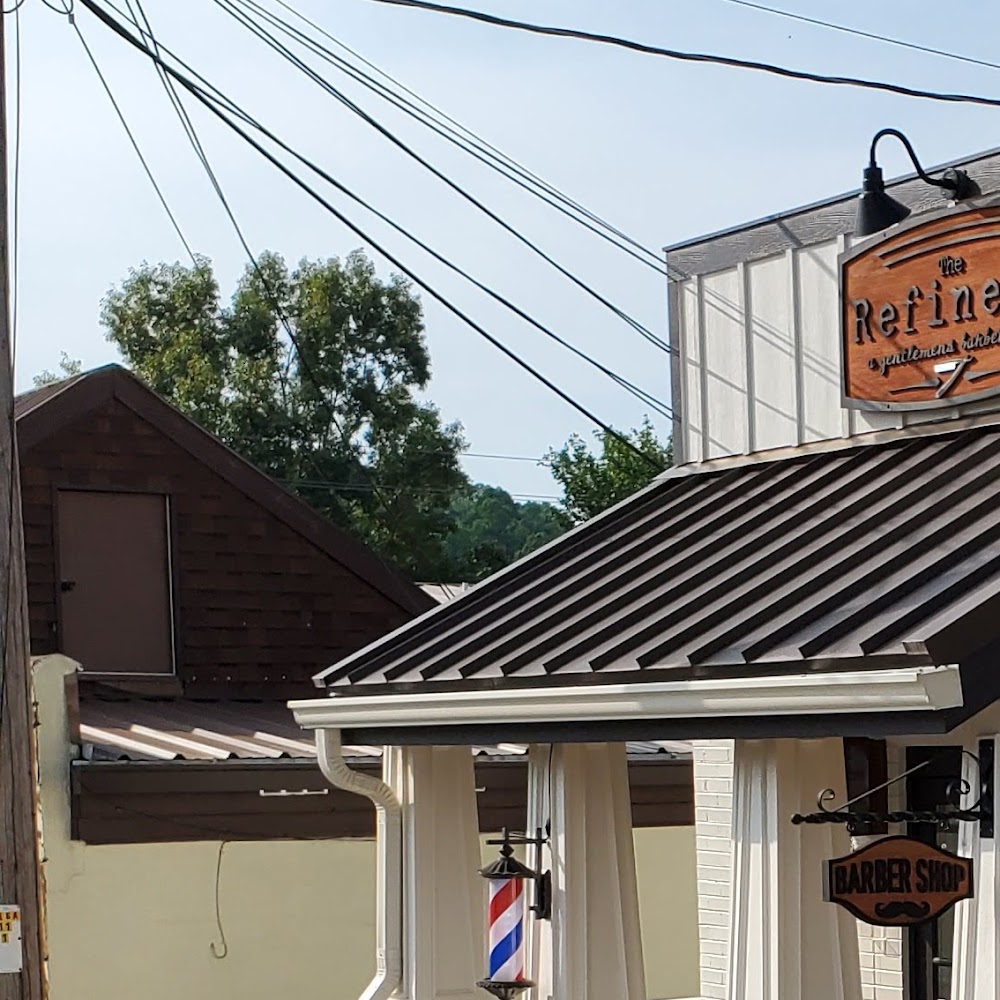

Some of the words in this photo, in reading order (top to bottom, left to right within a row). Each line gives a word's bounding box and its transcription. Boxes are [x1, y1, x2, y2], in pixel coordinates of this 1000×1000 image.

[938, 255, 966, 277] The
[879, 340, 957, 377] gentlemens
[835, 858, 912, 894] BARBER
[915, 858, 967, 894] SHOP
